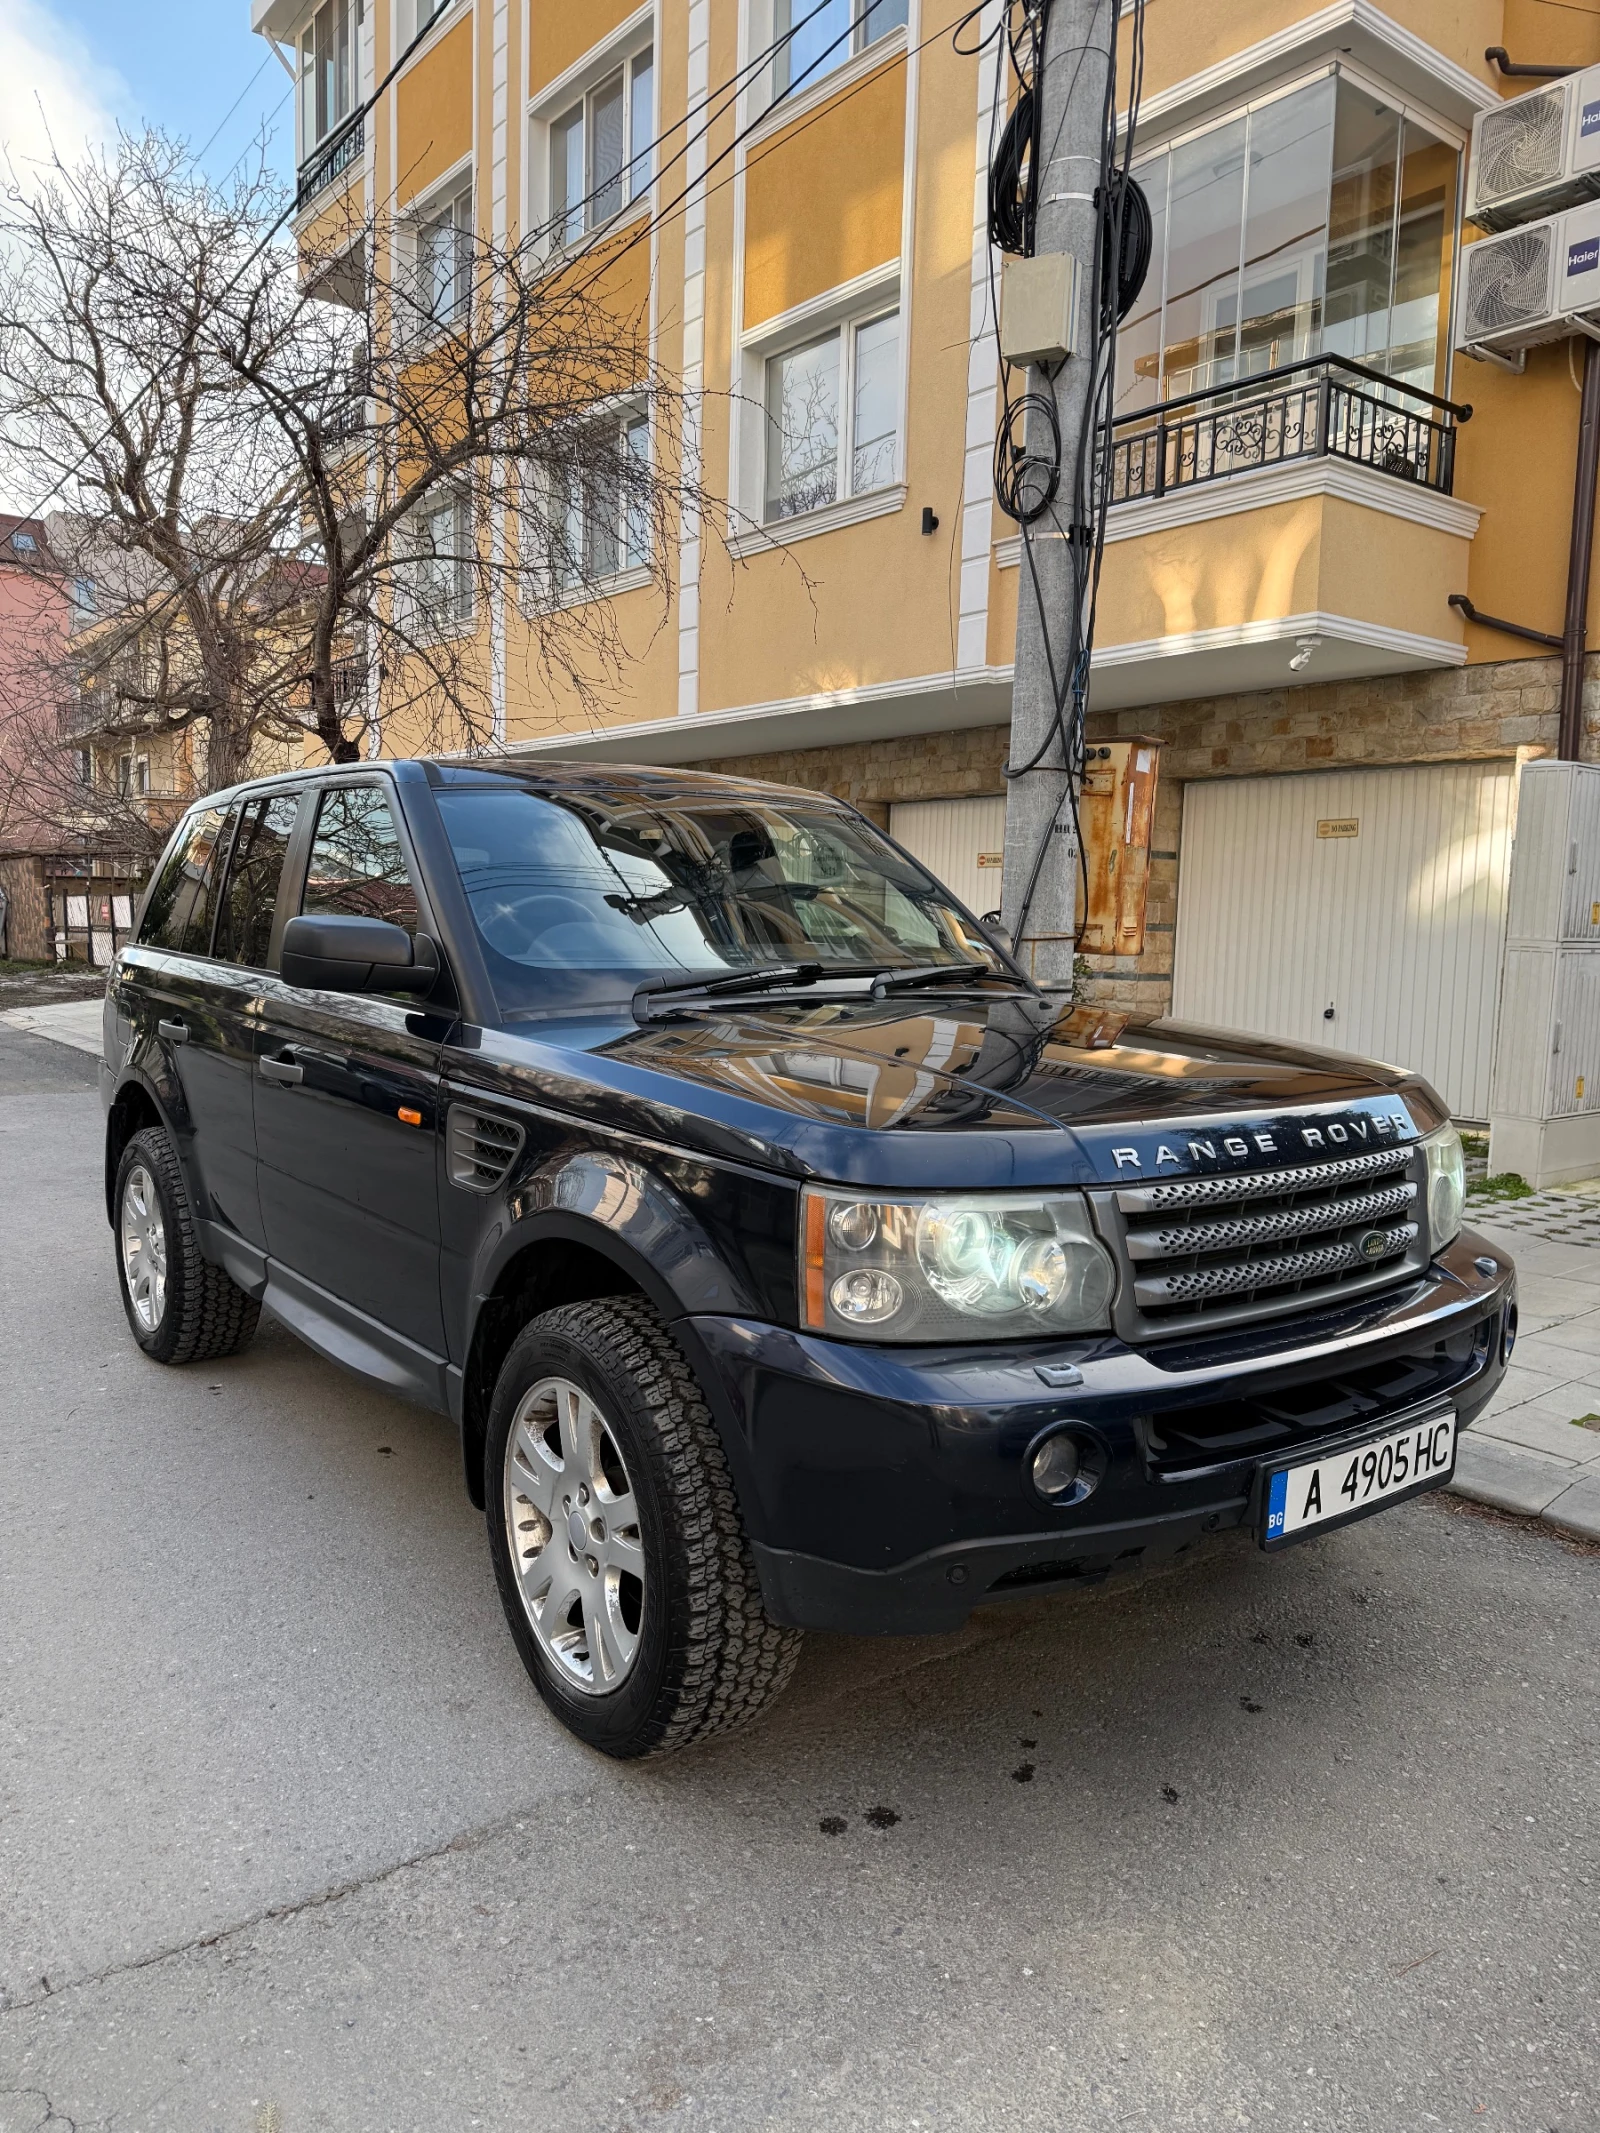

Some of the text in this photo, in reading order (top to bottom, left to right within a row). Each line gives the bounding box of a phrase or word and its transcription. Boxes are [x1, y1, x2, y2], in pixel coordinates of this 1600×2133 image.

[1583, 111, 1600, 125] Hai
[1568, 250, 1598, 267] Haier
[1112, 1113, 1409, 1169] RANGE ROVER
[1302, 1422, 1450, 1520] A 4905 HC
[1268, 1512, 1283, 1528] BG
